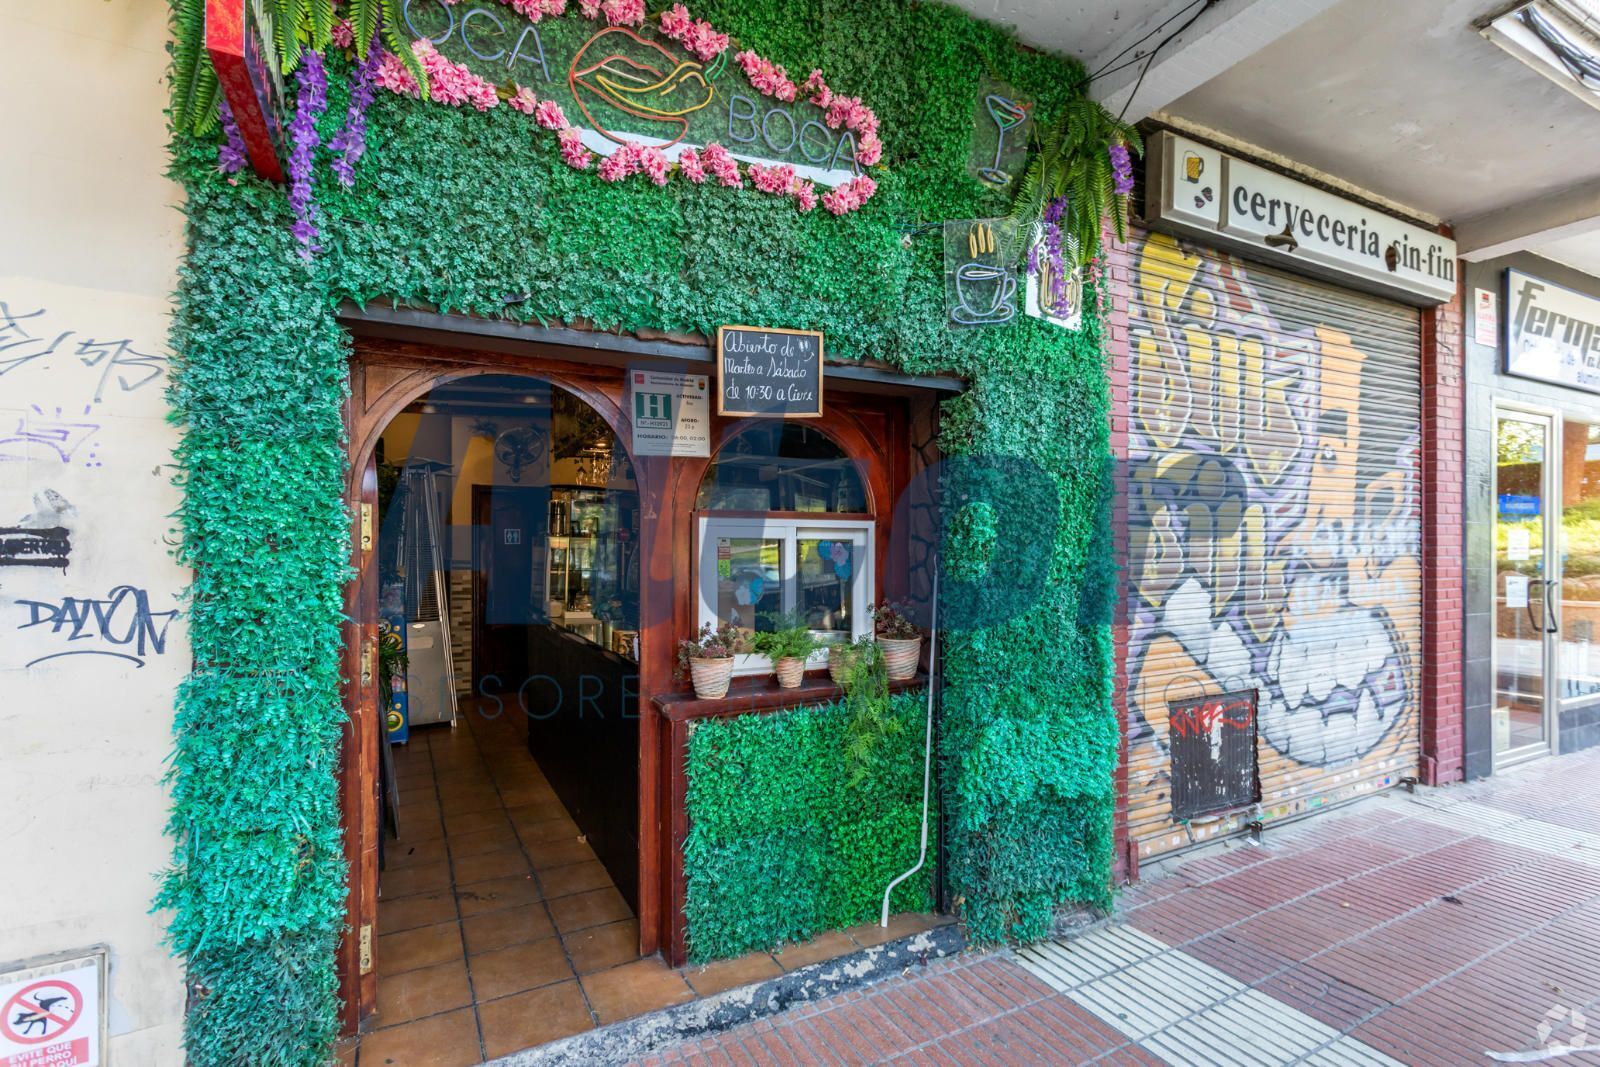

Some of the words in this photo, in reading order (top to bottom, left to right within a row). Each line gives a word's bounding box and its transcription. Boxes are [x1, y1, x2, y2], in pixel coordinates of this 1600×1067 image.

[729, 95, 861, 176] BOCA
[1233, 186, 1380, 258] cerveceria
[724, 331, 778, 354] Abierto
[780, 335, 795, 357] de
[724, 356, 755, 375] Martes
[766, 356, 807, 378] Sábado
[726, 378, 740, 400] de
[745, 385, 773, 401] 10:30
[776, 388, 786, 401] a
[788, 383, 813, 402] Cierre
[9, 1047, 44, 1064] EVITE
[46, 1041, 72, 1055] QUE
[30, 1050, 72, 1066] PERRO
